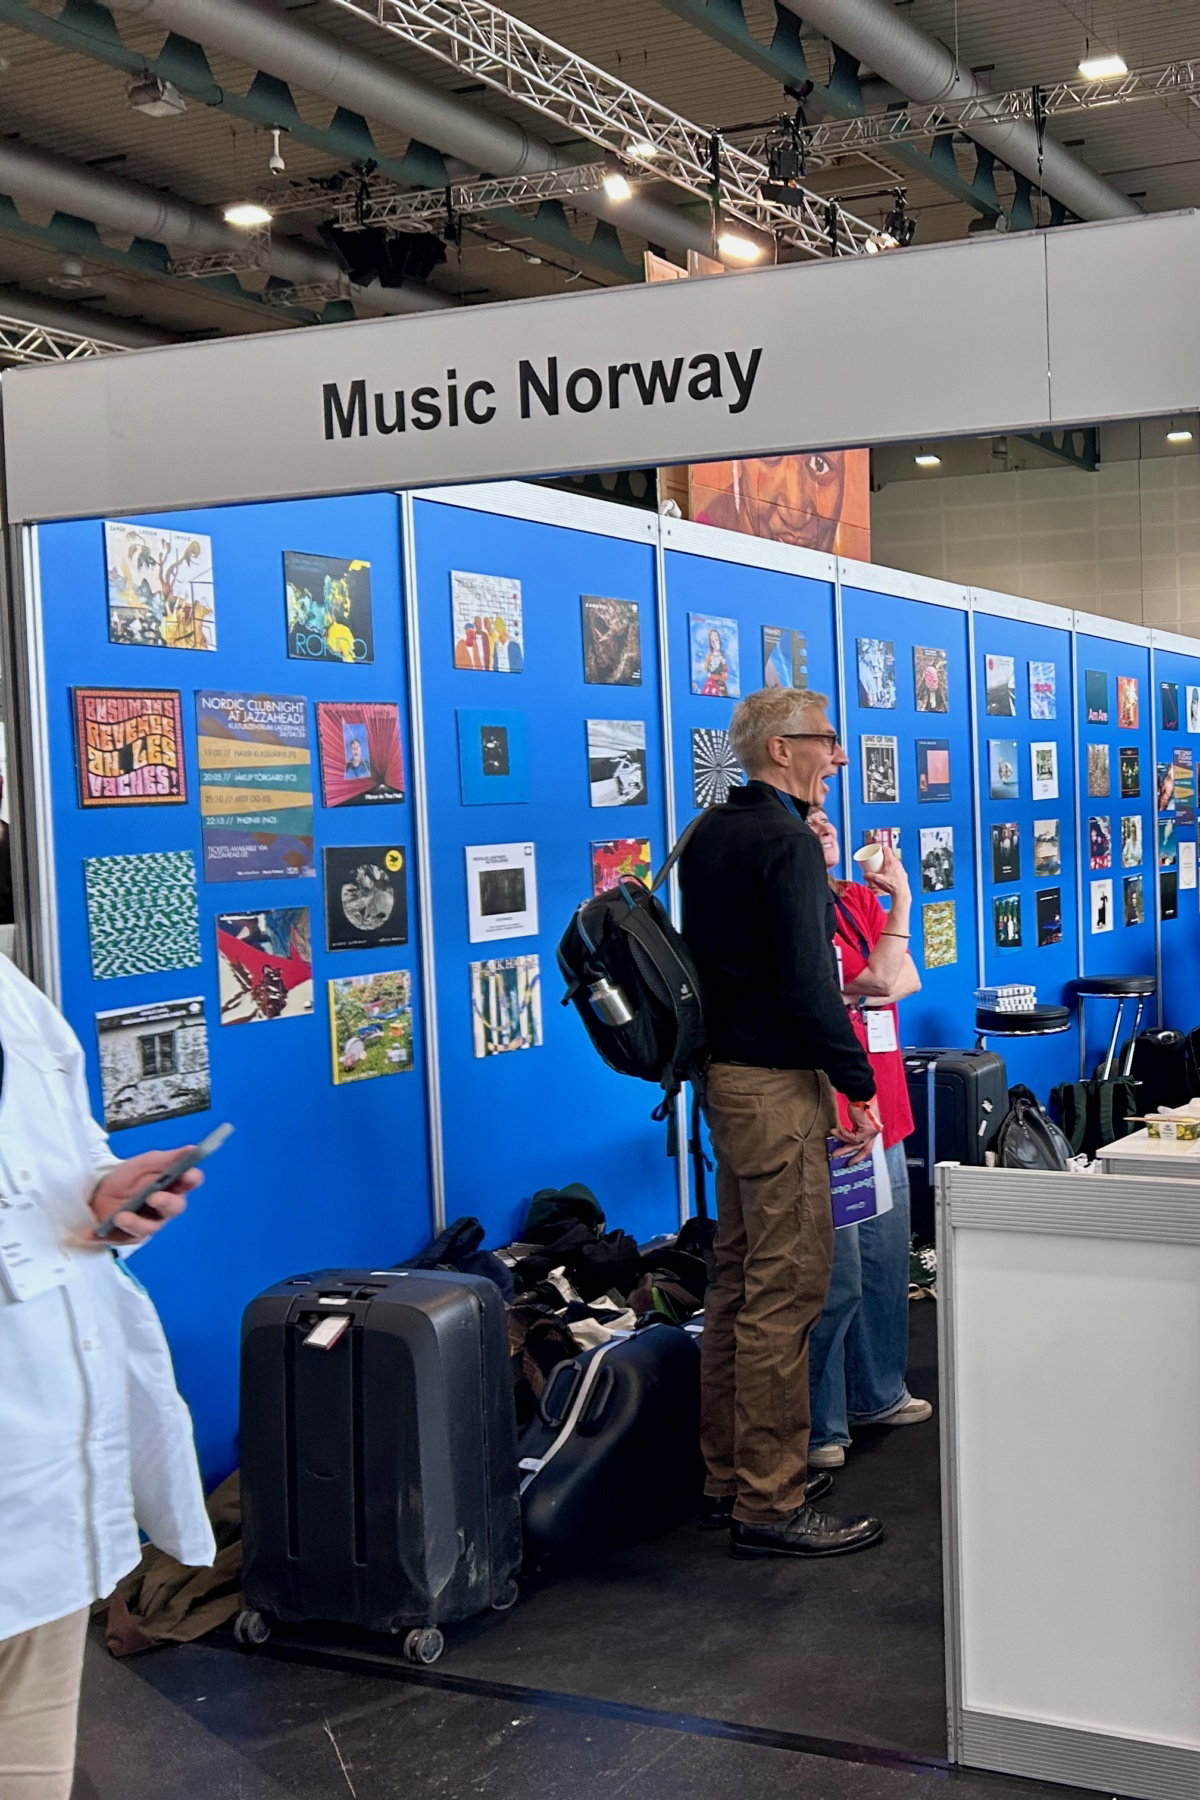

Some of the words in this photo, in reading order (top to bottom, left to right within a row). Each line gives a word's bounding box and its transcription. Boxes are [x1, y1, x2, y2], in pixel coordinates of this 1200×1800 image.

[323, 368, 496, 440] Music
[518, 347, 763, 419] Norway
[201, 697, 245, 711] NORDIC
[247, 699, 305, 713] CLUBNIGHT
[228, 710, 240, 722] AT
[242, 710, 304, 724] JAZZAHEAD!
